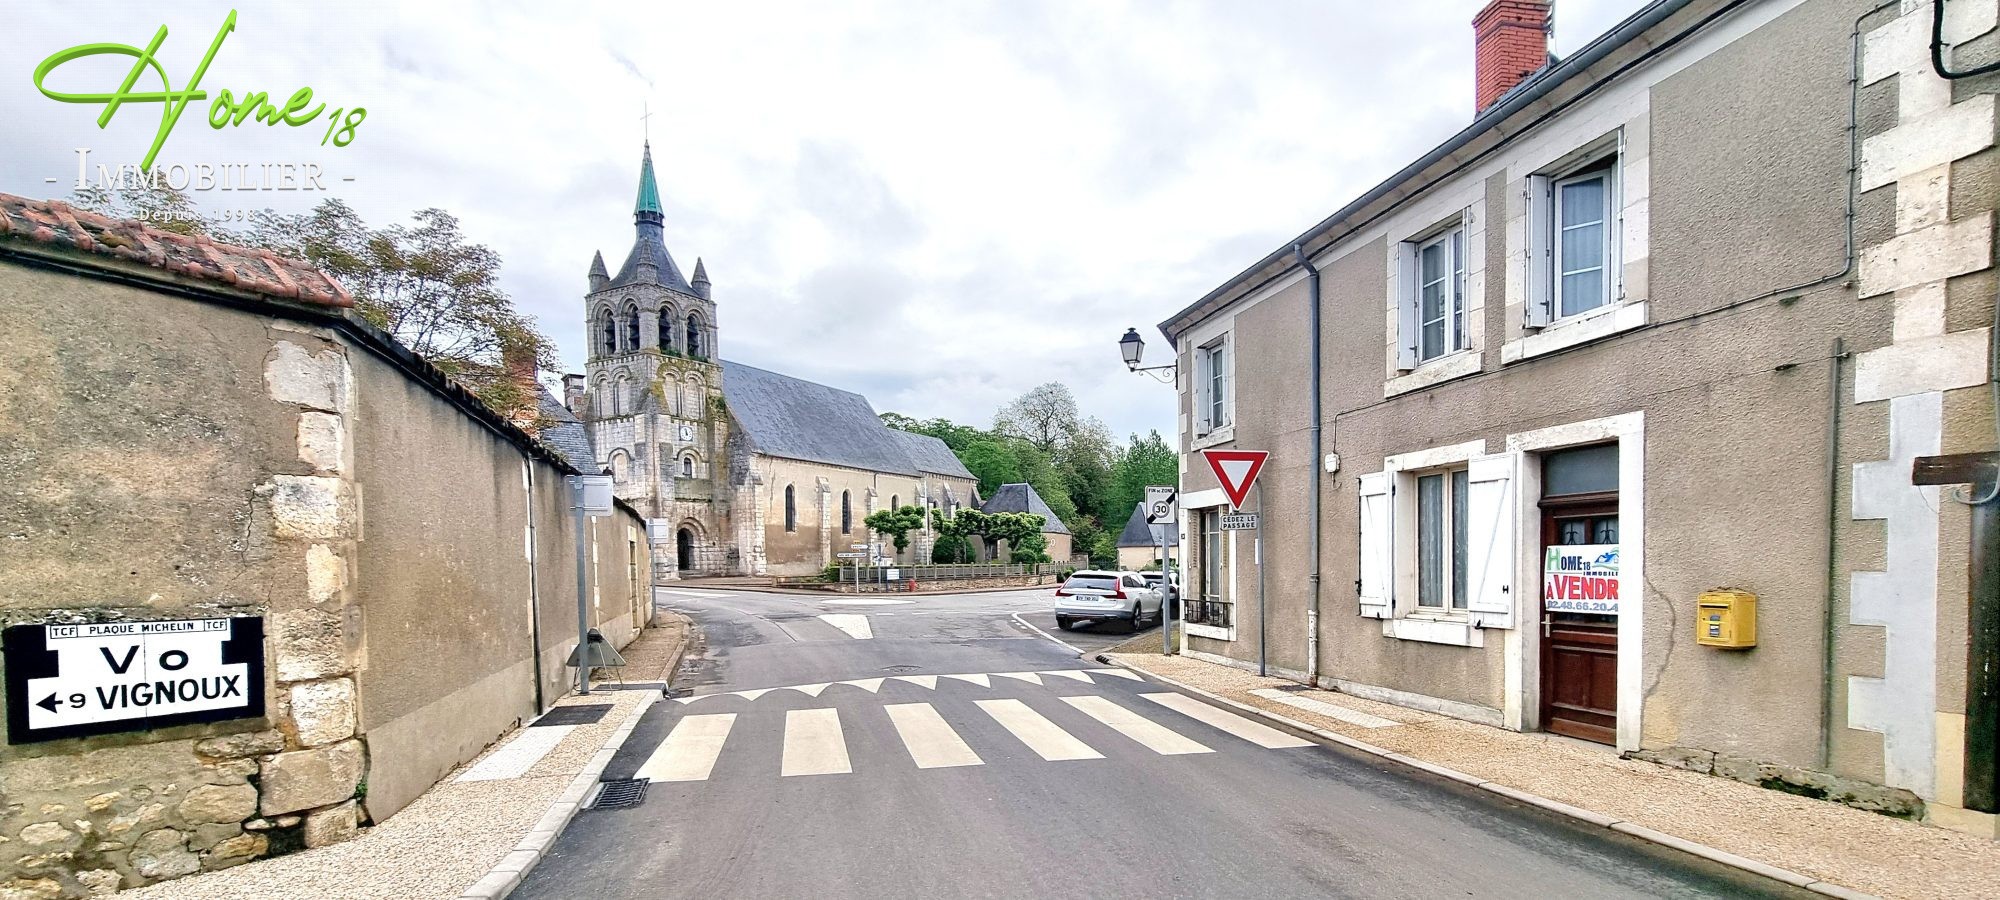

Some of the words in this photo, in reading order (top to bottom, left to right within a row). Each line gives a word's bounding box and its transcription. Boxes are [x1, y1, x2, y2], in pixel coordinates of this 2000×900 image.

[1155, 505, 1167, 513] 30
[1553, 574, 1618, 600] VENDR
[1547, 600, 1618, 612] 02.48.66.20.4
[53, 627, 75, 637] TCF
[89, 624, 134, 635] PLAQUE
[141, 622, 195, 635] MICHELIN
[206, 620, 226, 630] TCF
[69, 693, 86, 708] 9
[96, 675, 241, 710] VIGNOUX
